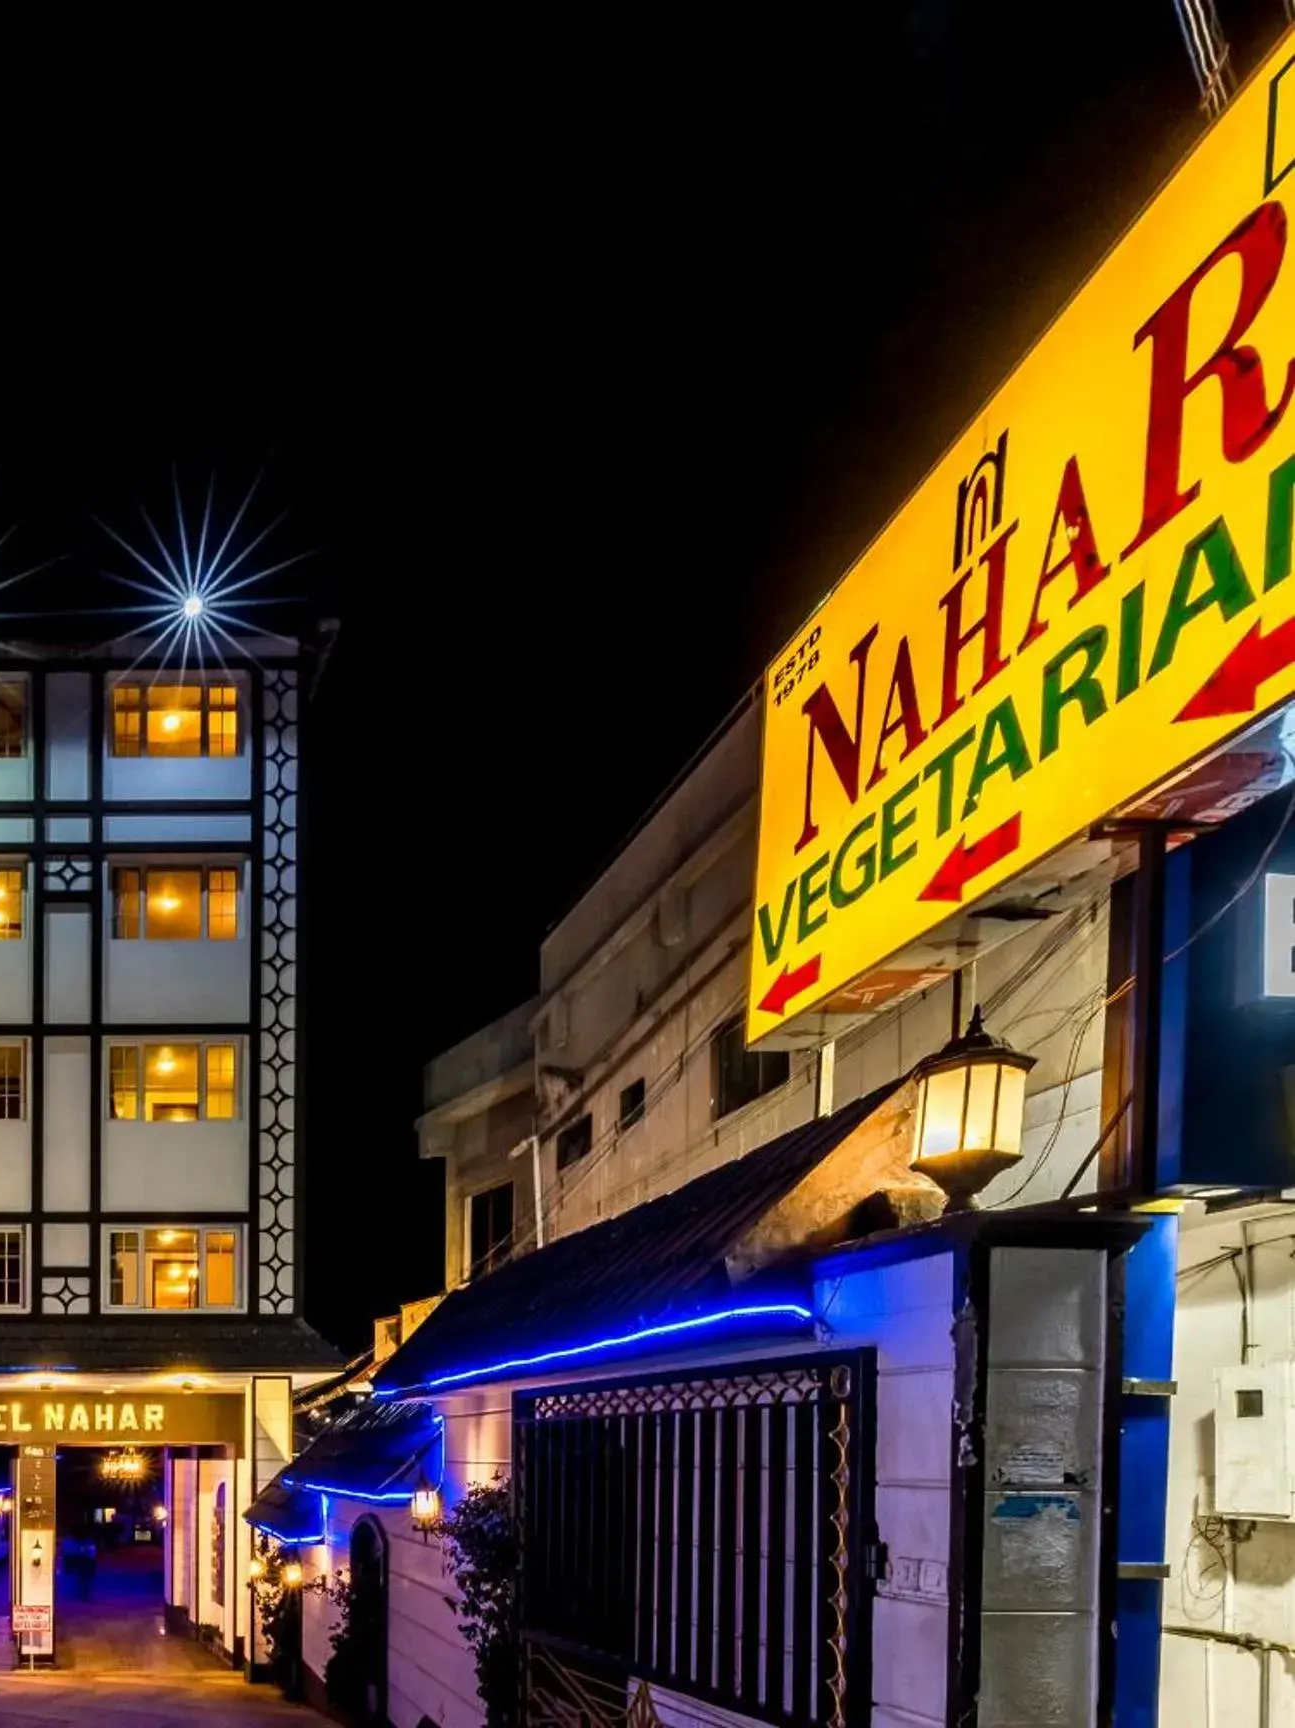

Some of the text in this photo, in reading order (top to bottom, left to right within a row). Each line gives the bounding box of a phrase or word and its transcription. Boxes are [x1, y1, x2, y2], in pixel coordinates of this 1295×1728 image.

[773, 625, 822, 688] ESTD
[773, 649, 821, 708] 1978
[43, 1403, 165, 1433] NAHAR
